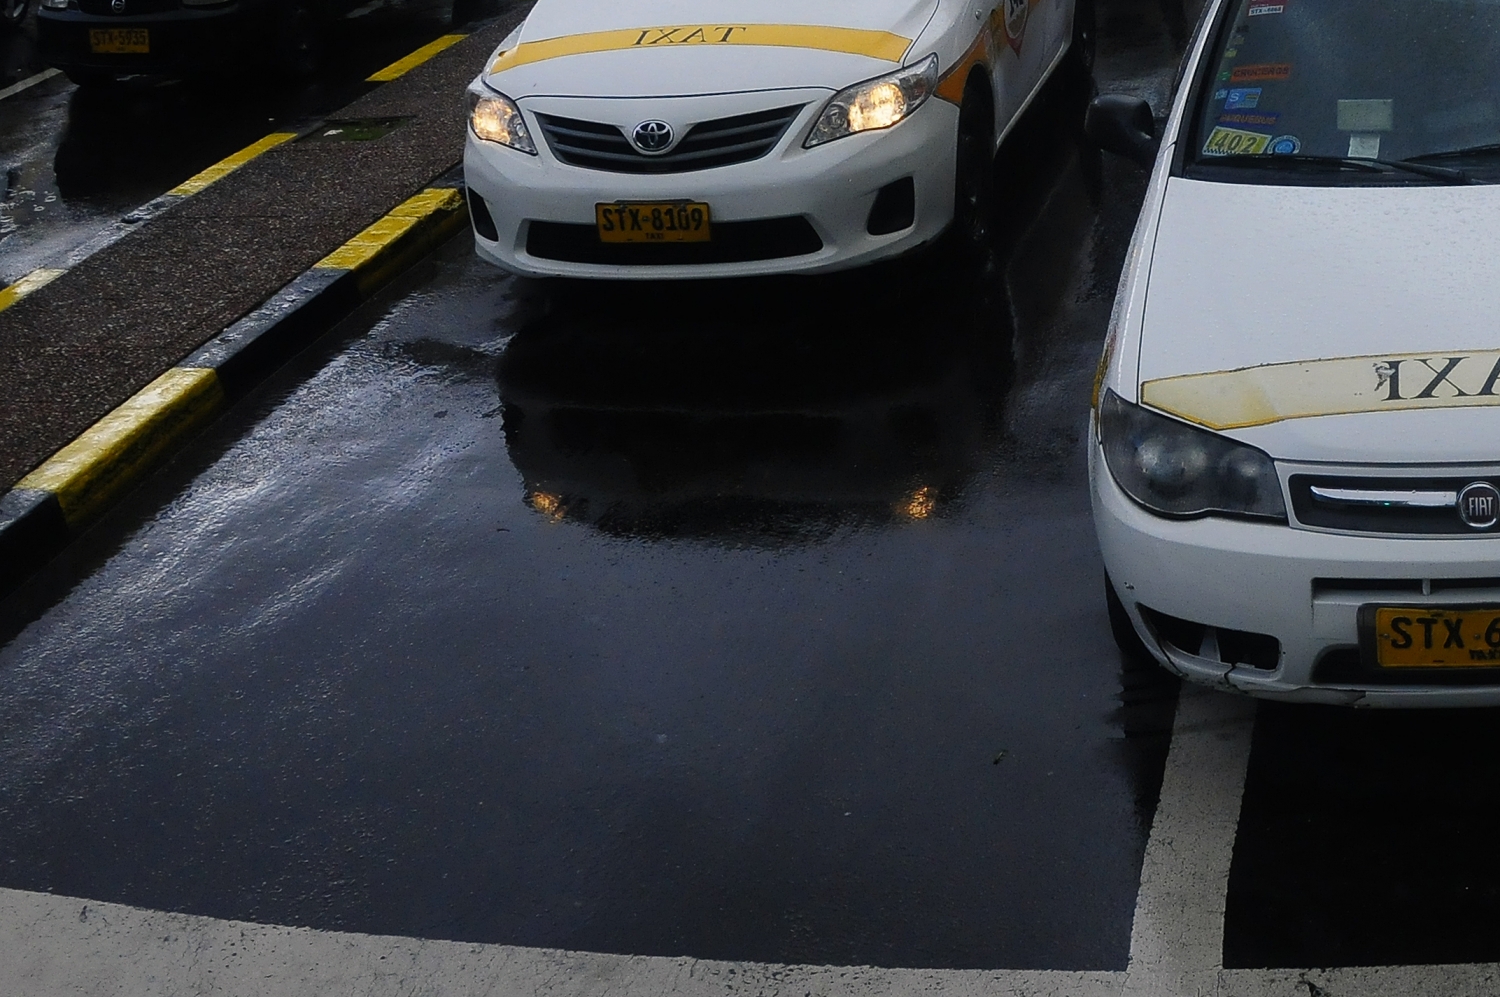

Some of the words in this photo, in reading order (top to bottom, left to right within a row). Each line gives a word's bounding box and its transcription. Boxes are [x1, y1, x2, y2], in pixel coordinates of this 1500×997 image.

[1214, 132, 1258, 153] 402
[645, 232, 664, 240] TAXI
[1467, 495, 1495, 517] FIAT
